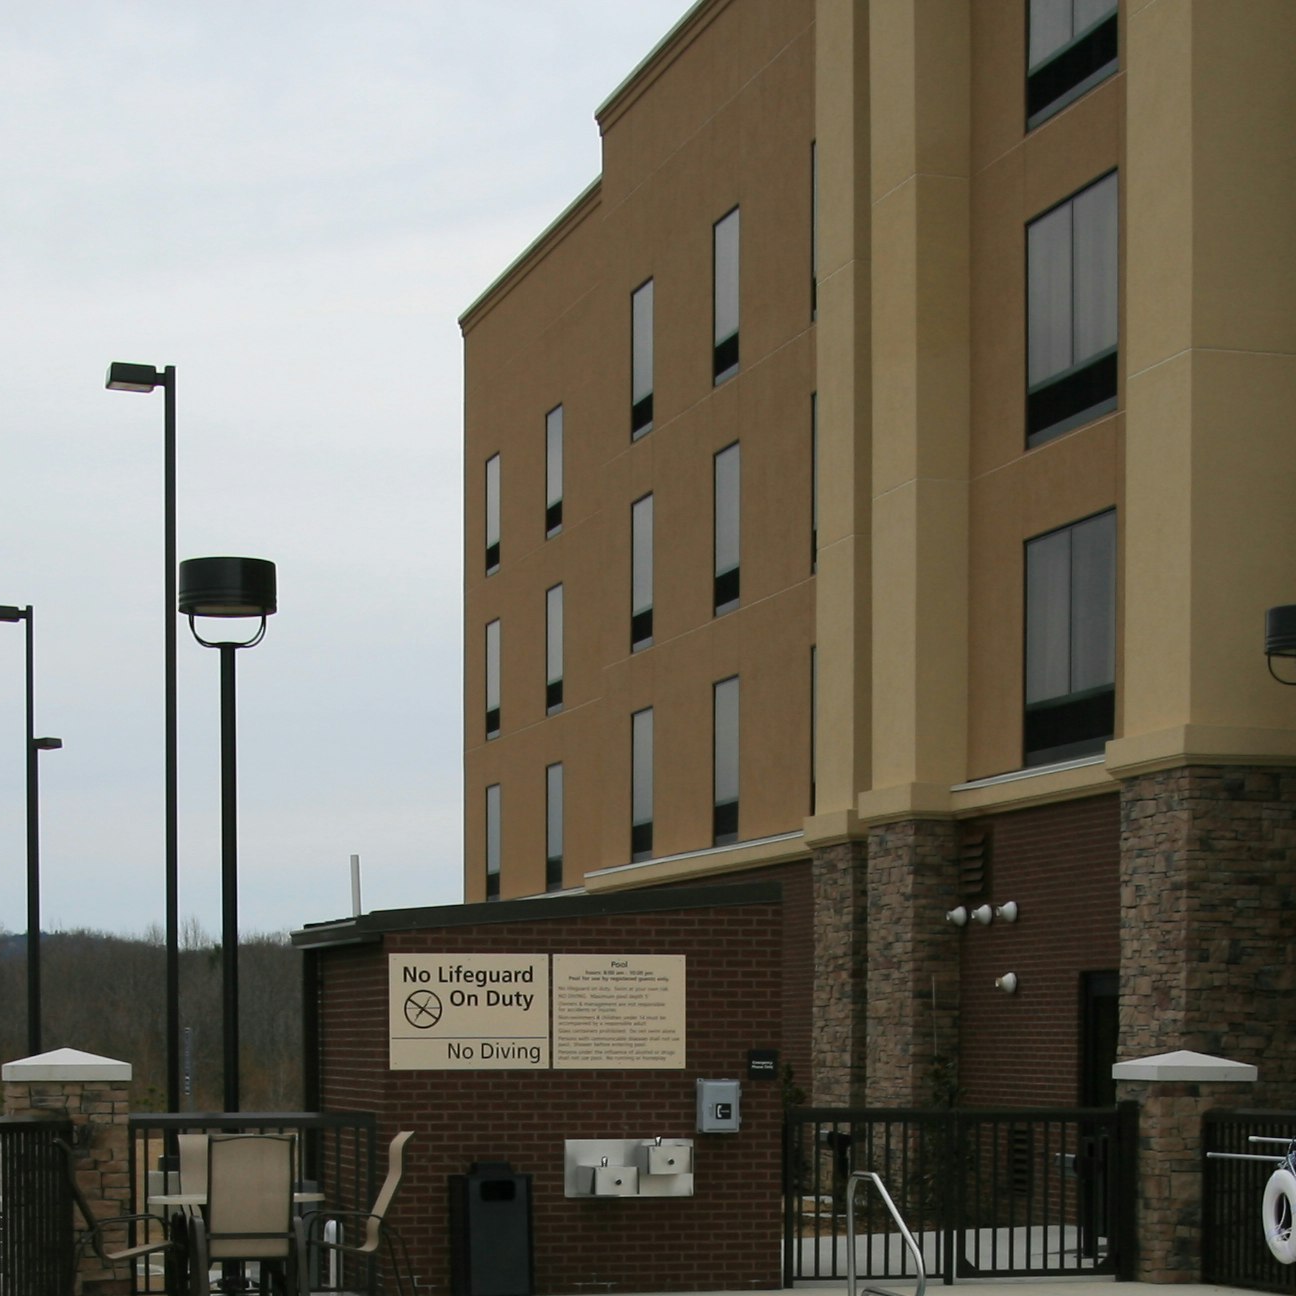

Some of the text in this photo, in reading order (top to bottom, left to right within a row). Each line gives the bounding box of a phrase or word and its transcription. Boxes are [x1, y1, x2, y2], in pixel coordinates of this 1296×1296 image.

[403, 965, 534, 988] No Lifeguard
[450, 990, 534, 1011] On Duty
[448, 1042, 541, 1064] No Diving
